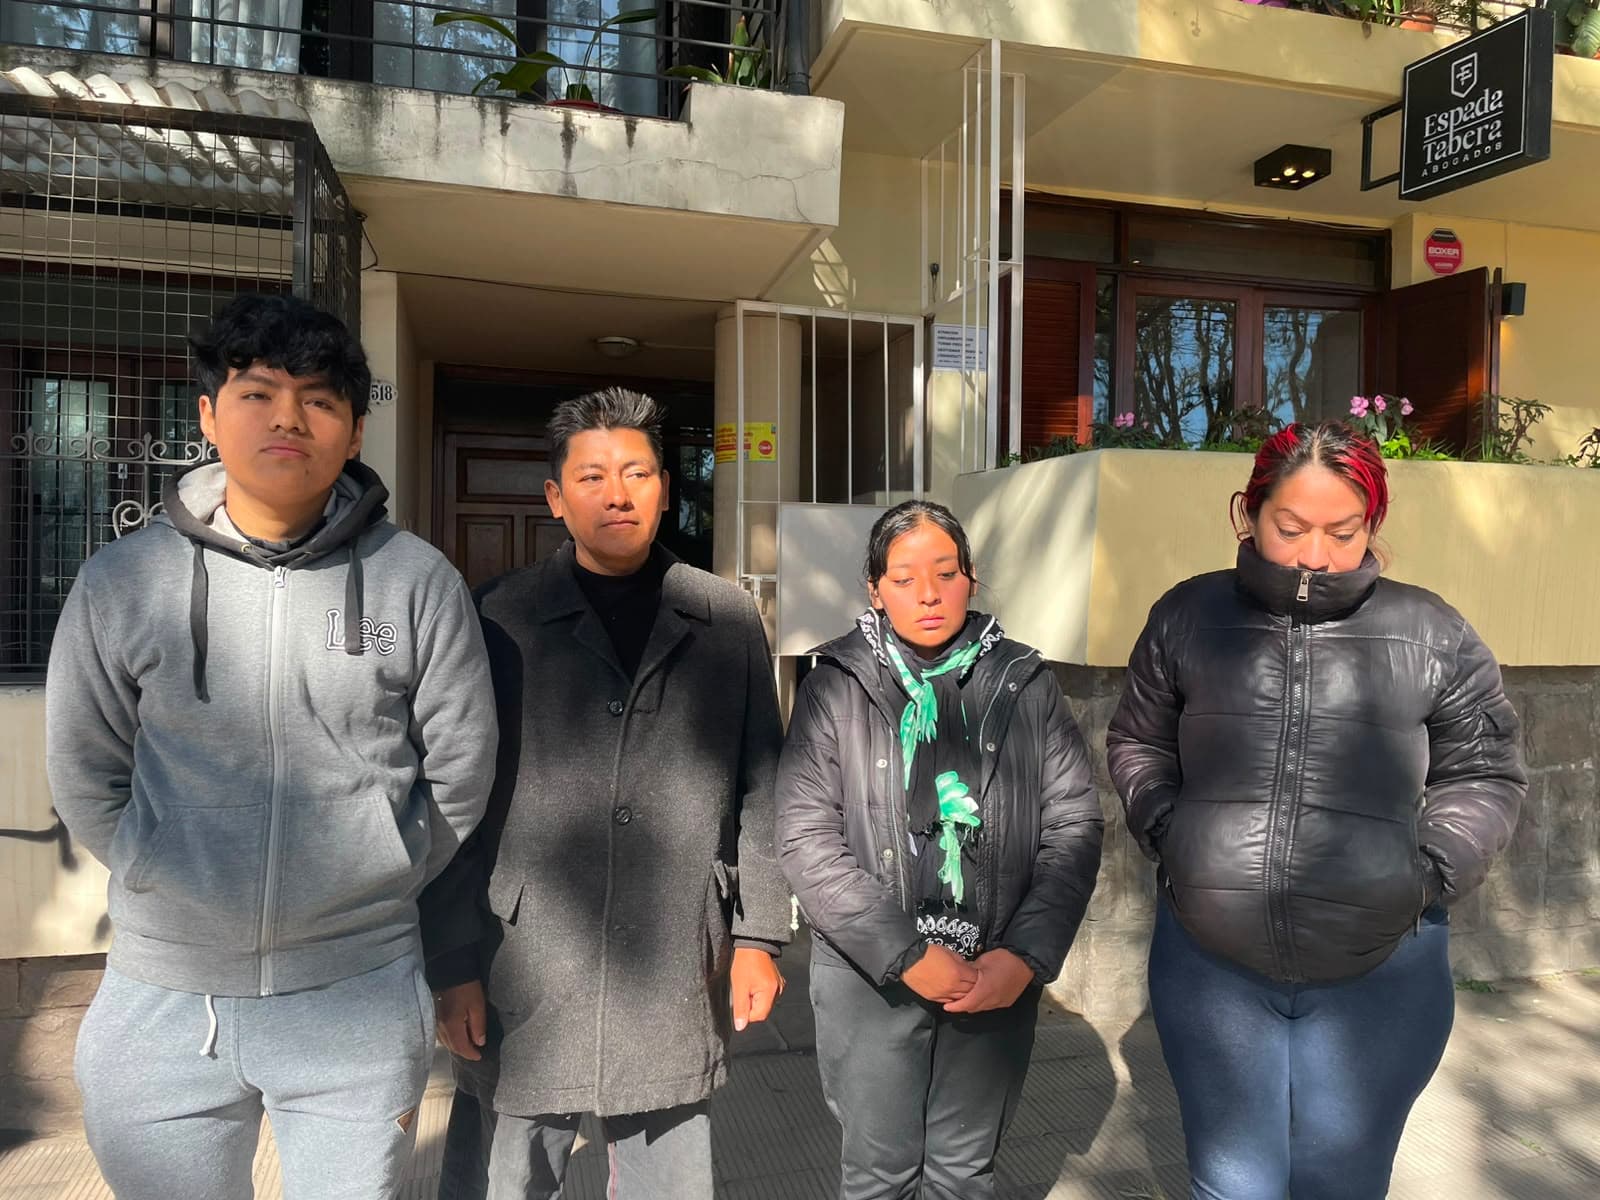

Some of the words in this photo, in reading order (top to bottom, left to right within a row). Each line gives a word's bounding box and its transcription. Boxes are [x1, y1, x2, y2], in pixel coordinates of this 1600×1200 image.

[1423, 87, 1504, 139] Espada
[1421, 142, 1502, 177] ABOGADOS
[1422, 119, 1503, 165] Tabera
[371, 384, 393, 401] 518
[325, 609, 397, 656] Lee
